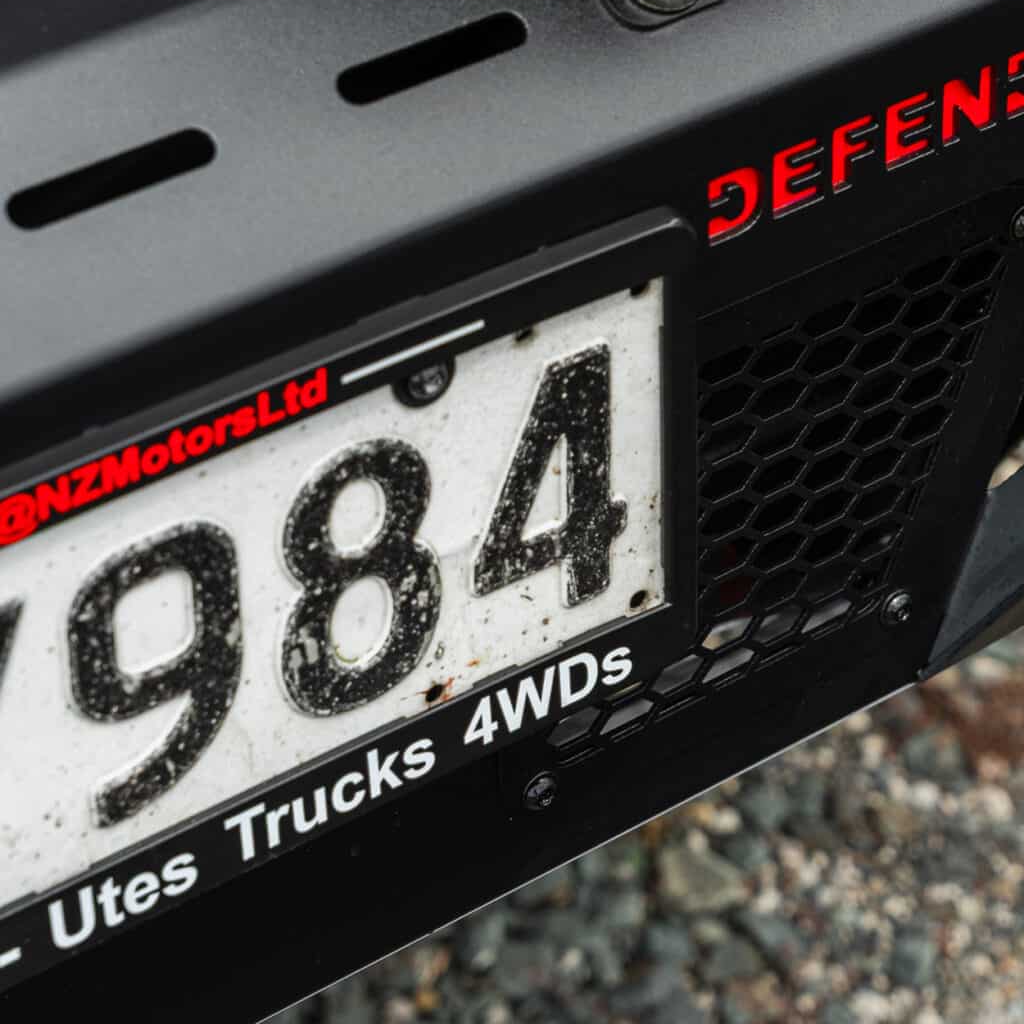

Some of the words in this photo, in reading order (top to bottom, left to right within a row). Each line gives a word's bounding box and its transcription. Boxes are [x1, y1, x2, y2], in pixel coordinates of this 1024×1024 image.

[0, 367, 328, 546] @NZMotorsLtd
[0, 341, 628, 831] 984
[49, 854, 197, 948] Utes
[224, 739, 435, 860] Trucks
[464, 647, 632, 744] 4WDs
